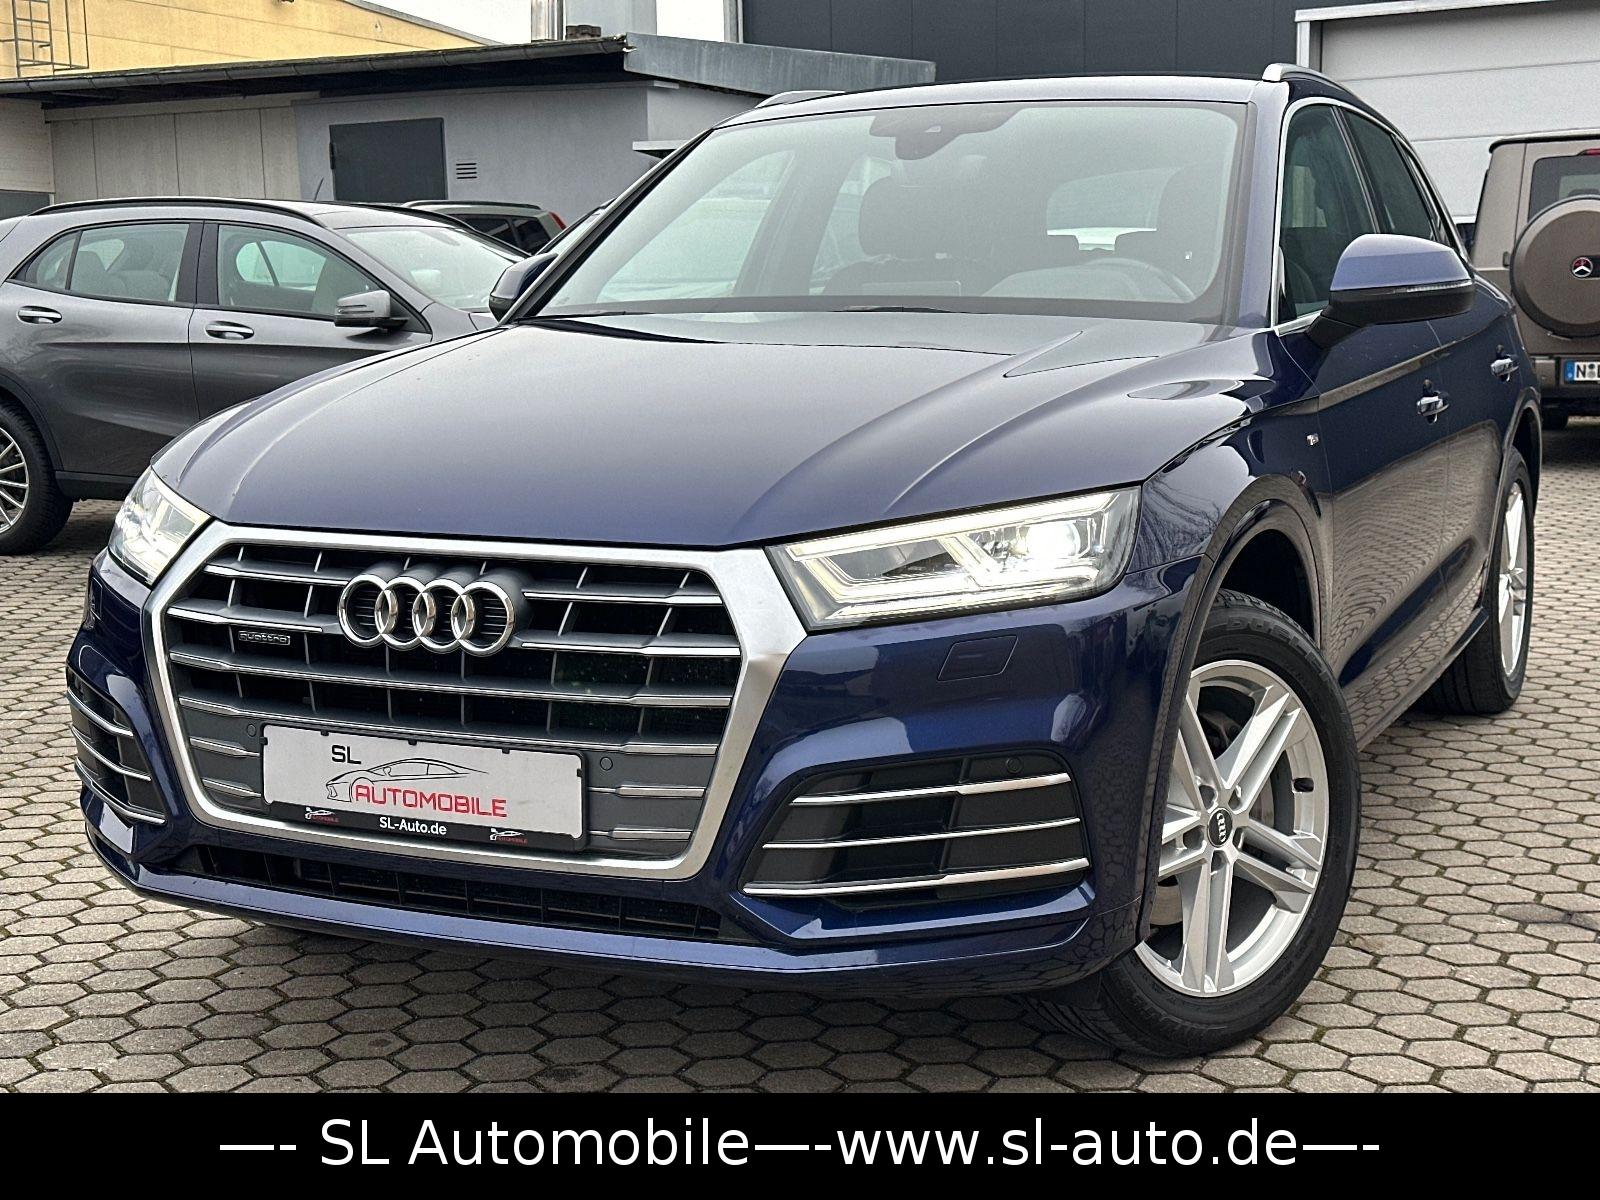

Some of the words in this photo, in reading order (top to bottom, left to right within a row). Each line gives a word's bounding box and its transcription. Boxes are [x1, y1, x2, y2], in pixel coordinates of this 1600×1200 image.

[331, 744, 362, 765] SL
[355, 784, 508, 818] AUTOMOBILE
[379, 816, 447, 836] SL-Auto.de
